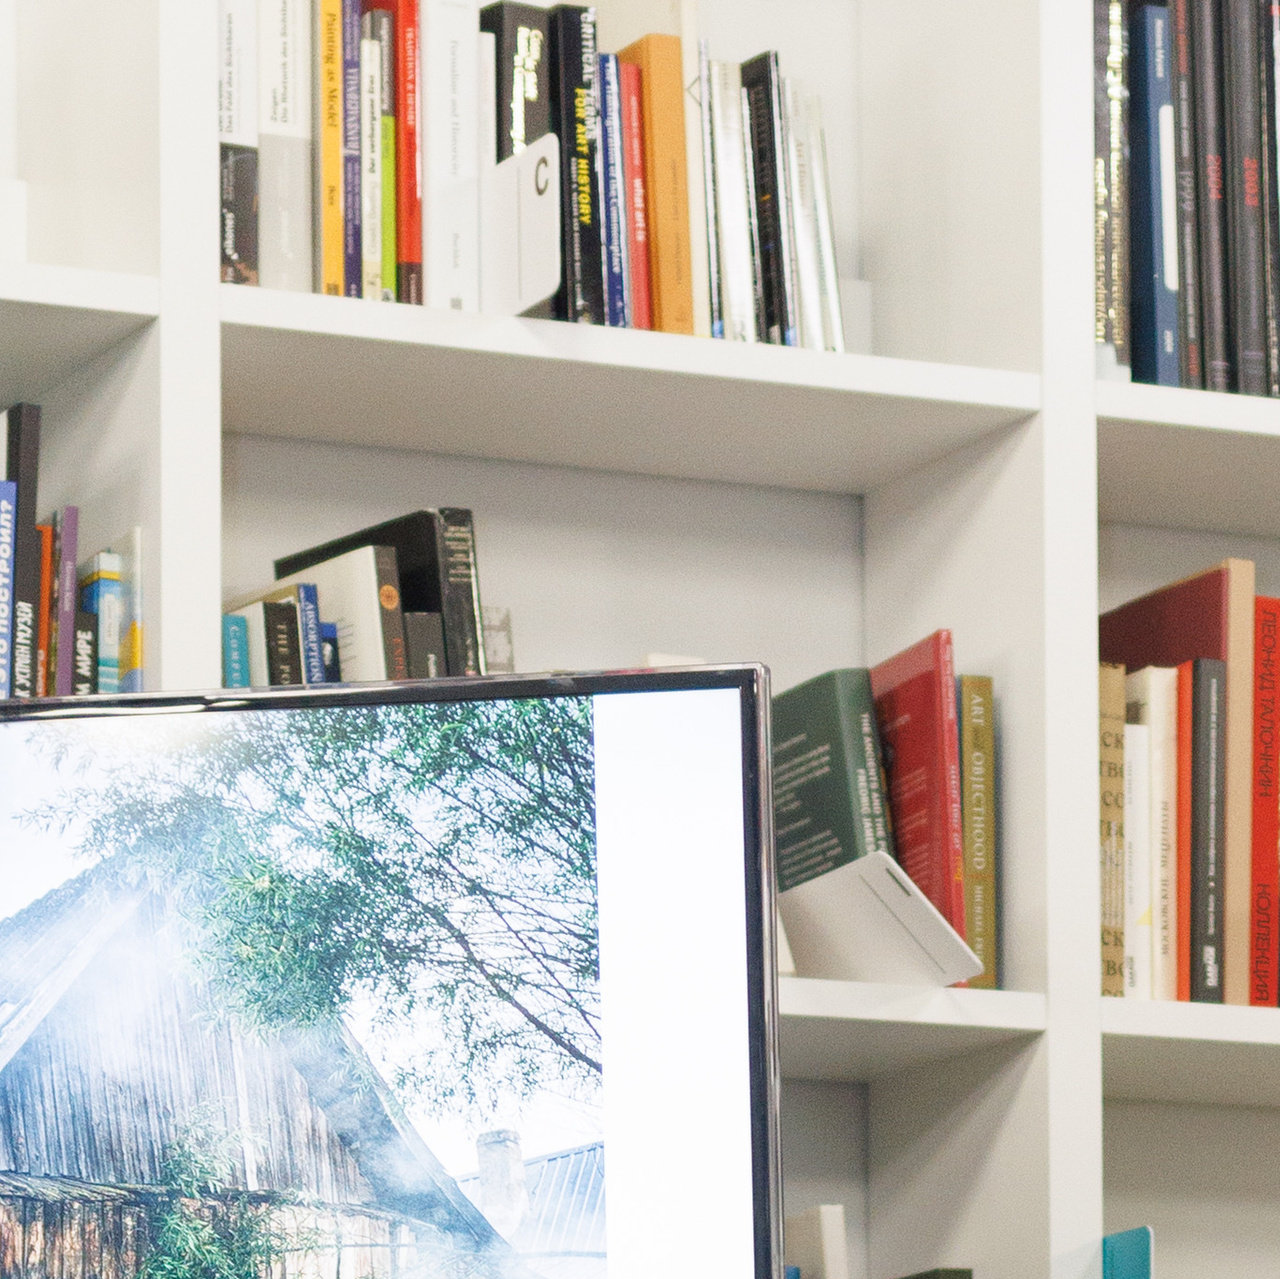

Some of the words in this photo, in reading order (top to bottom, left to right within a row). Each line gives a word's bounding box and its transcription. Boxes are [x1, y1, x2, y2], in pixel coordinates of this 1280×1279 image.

[324, 13, 338, 64] Painting
[580, 11, 596, 81] CRITICAL
[327, 69, 335, 82] as
[326, 87, 338, 128] Model
[574, 88, 588, 120] FOR
[576, 122, 589, 153] ART
[535, 156, 549, 196] C
[577, 158, 591, 224] HISTORY
[634, 178, 645, 208] what
[1207, 154, 1223, 200] 2004
[610, 198, 621, 273] Commonplace
[635, 211, 646, 228] art
[15, 601, 33, 644] МУЗЕЙ
[277, 624, 288, 654] THE
[305, 602, 322, 683] ABSORPTION
[76, 629, 92, 677] МИРЕ
[1260, 609, 1278, 690] ЛЕОНИД
[861, 713, 872, 734] THE
[970, 694, 984, 725] ART
[863, 737, 878, 789] ANCIENTS
[1257, 695, 1276, 797] ТАЛОЧКИН
[857, 769, 870, 814] FREDRIC
[872, 792, 882, 814] AND
[970, 750, 986, 871] OBJECTHOOD
[874, 817, 884, 837] THE
[973, 885, 984, 933] MICHAEL
[1254, 883, 1271, 1002] КОЛЛЕКЦИЯ
